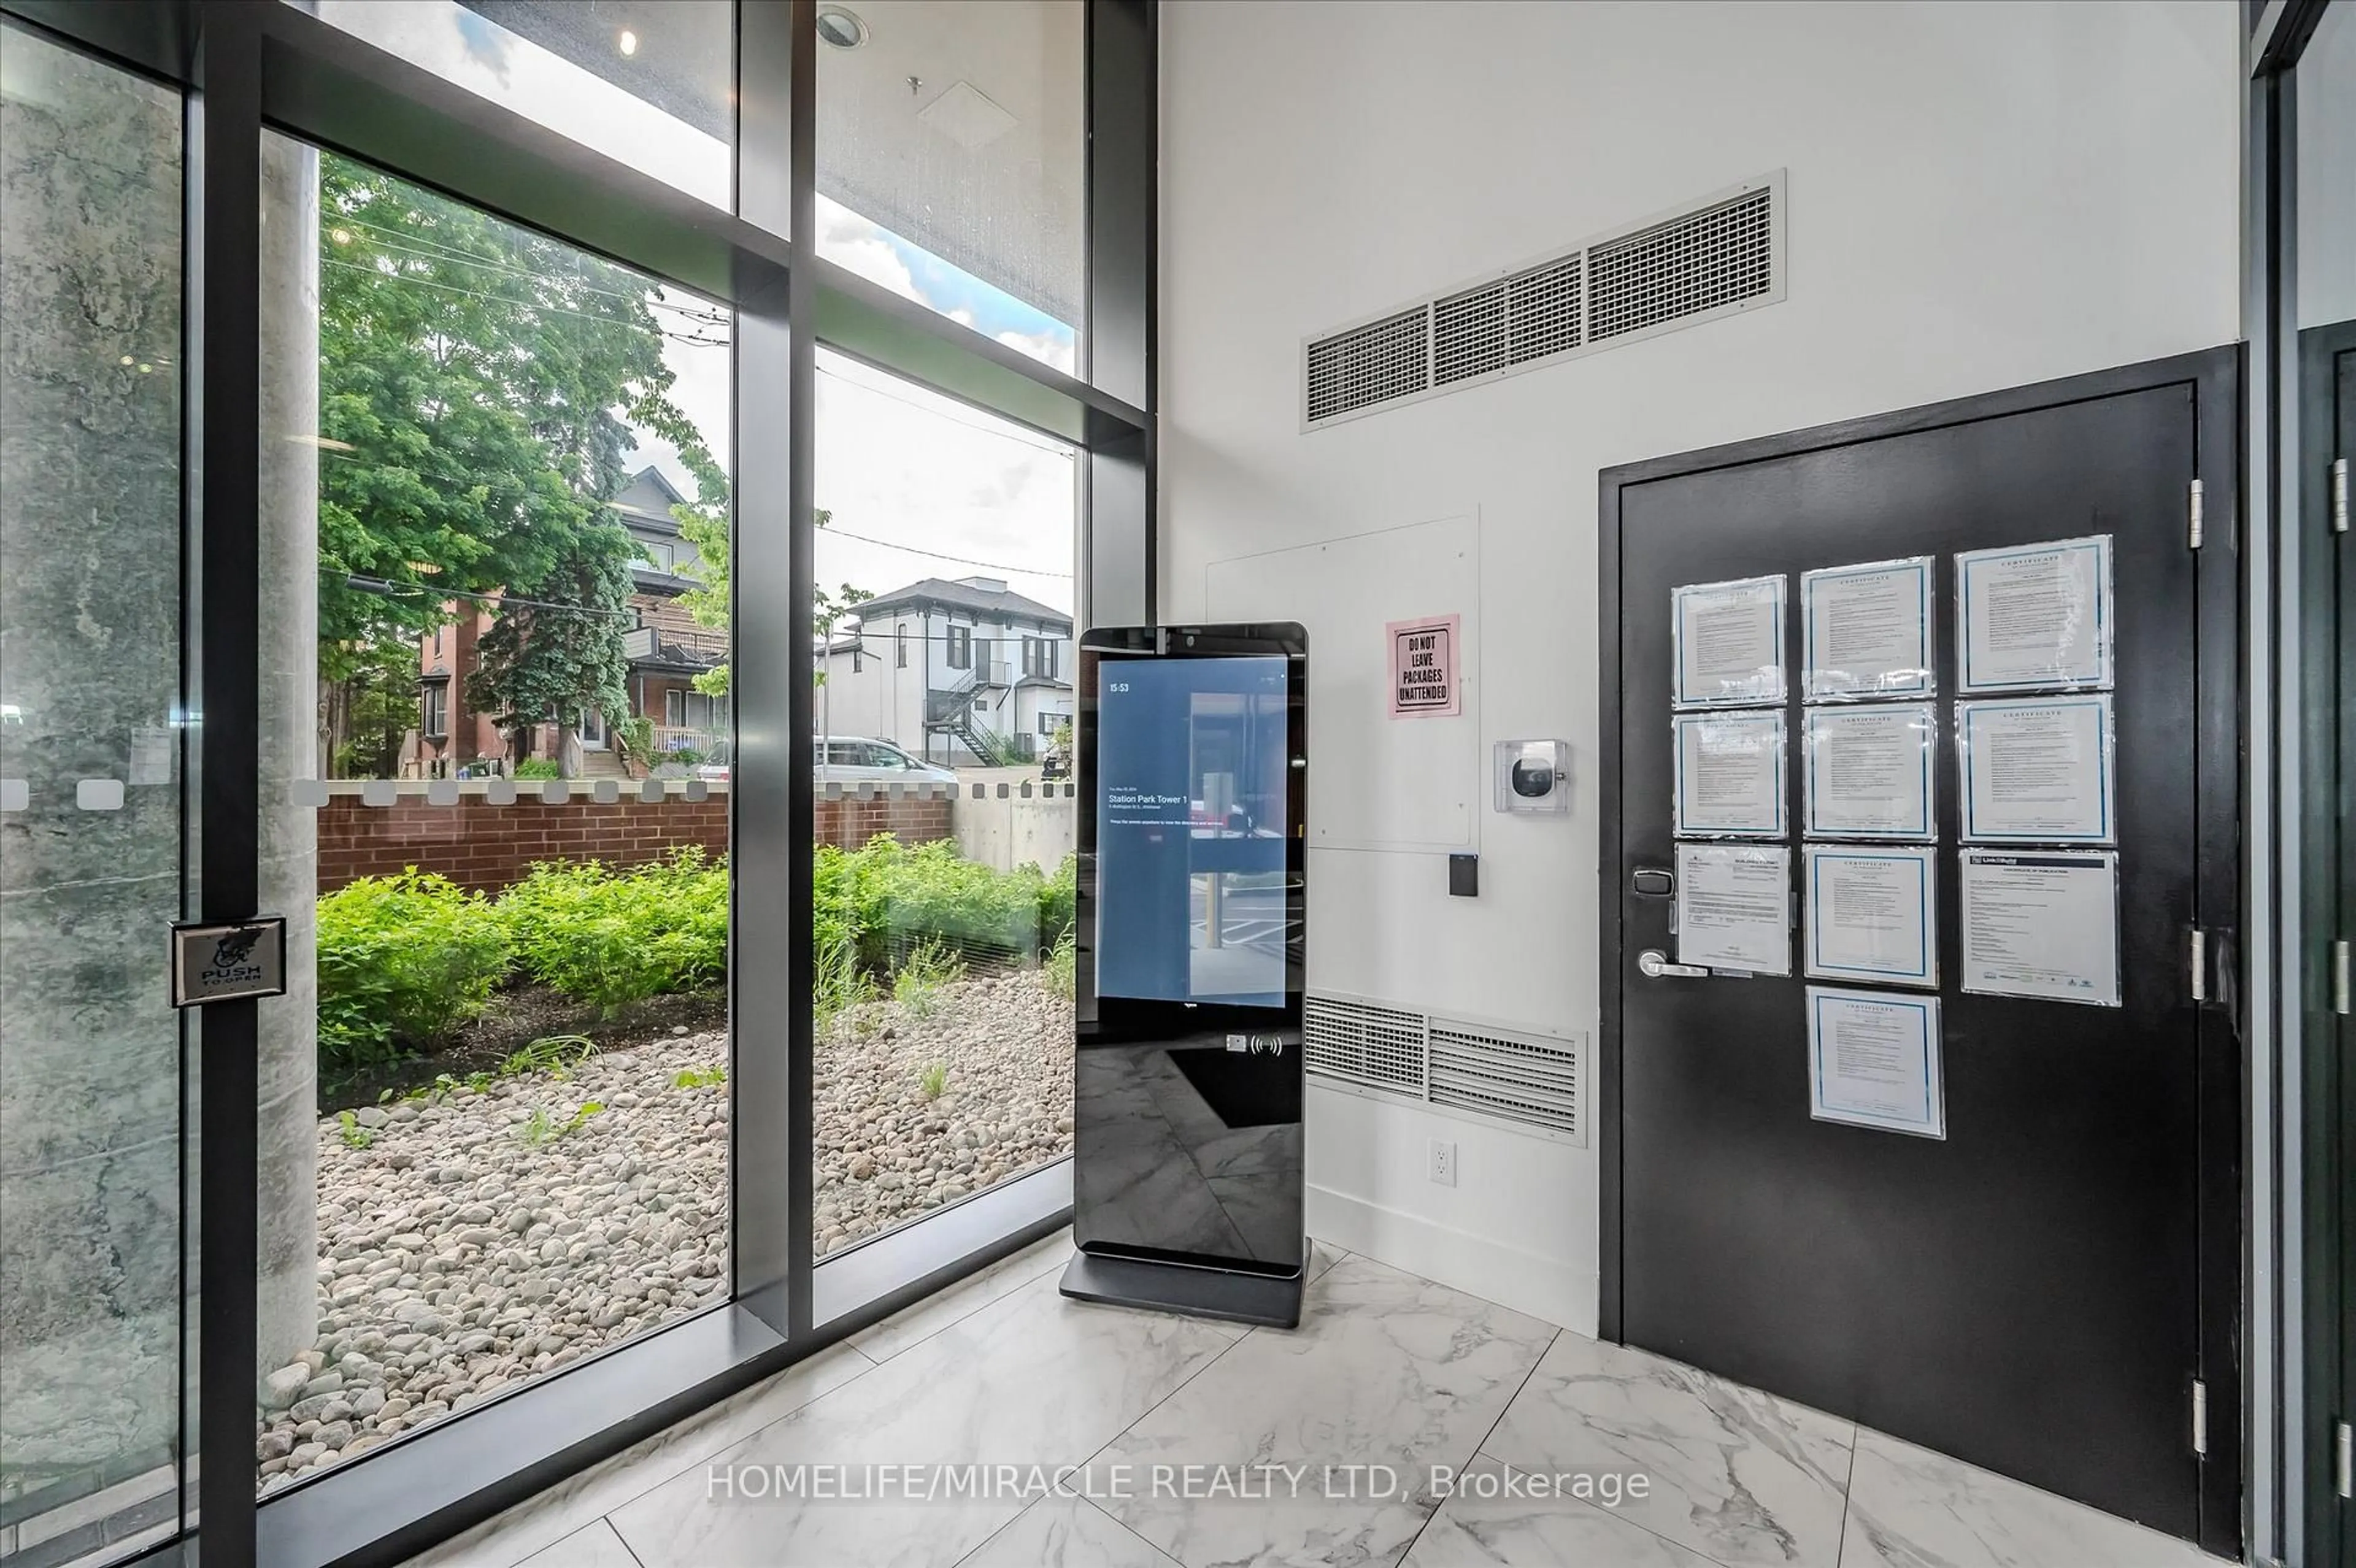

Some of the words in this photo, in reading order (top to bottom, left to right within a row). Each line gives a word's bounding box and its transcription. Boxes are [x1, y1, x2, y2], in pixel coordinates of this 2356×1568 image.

[1409, 637, 1419, 651] DO
[1420, 636, 1436, 650] NOT
[1412, 653, 1433, 667] LEAVE
[1403, 669, 1442, 684] PACKAGES
[1399, 686, 1446, 701] UNATTENDED
[1138, 795, 1156, 804] Park
[1157, 796, 1180, 804] Tower
[201, 966, 261, 980] PUSH
[225, 975, 261, 984] OPEN
